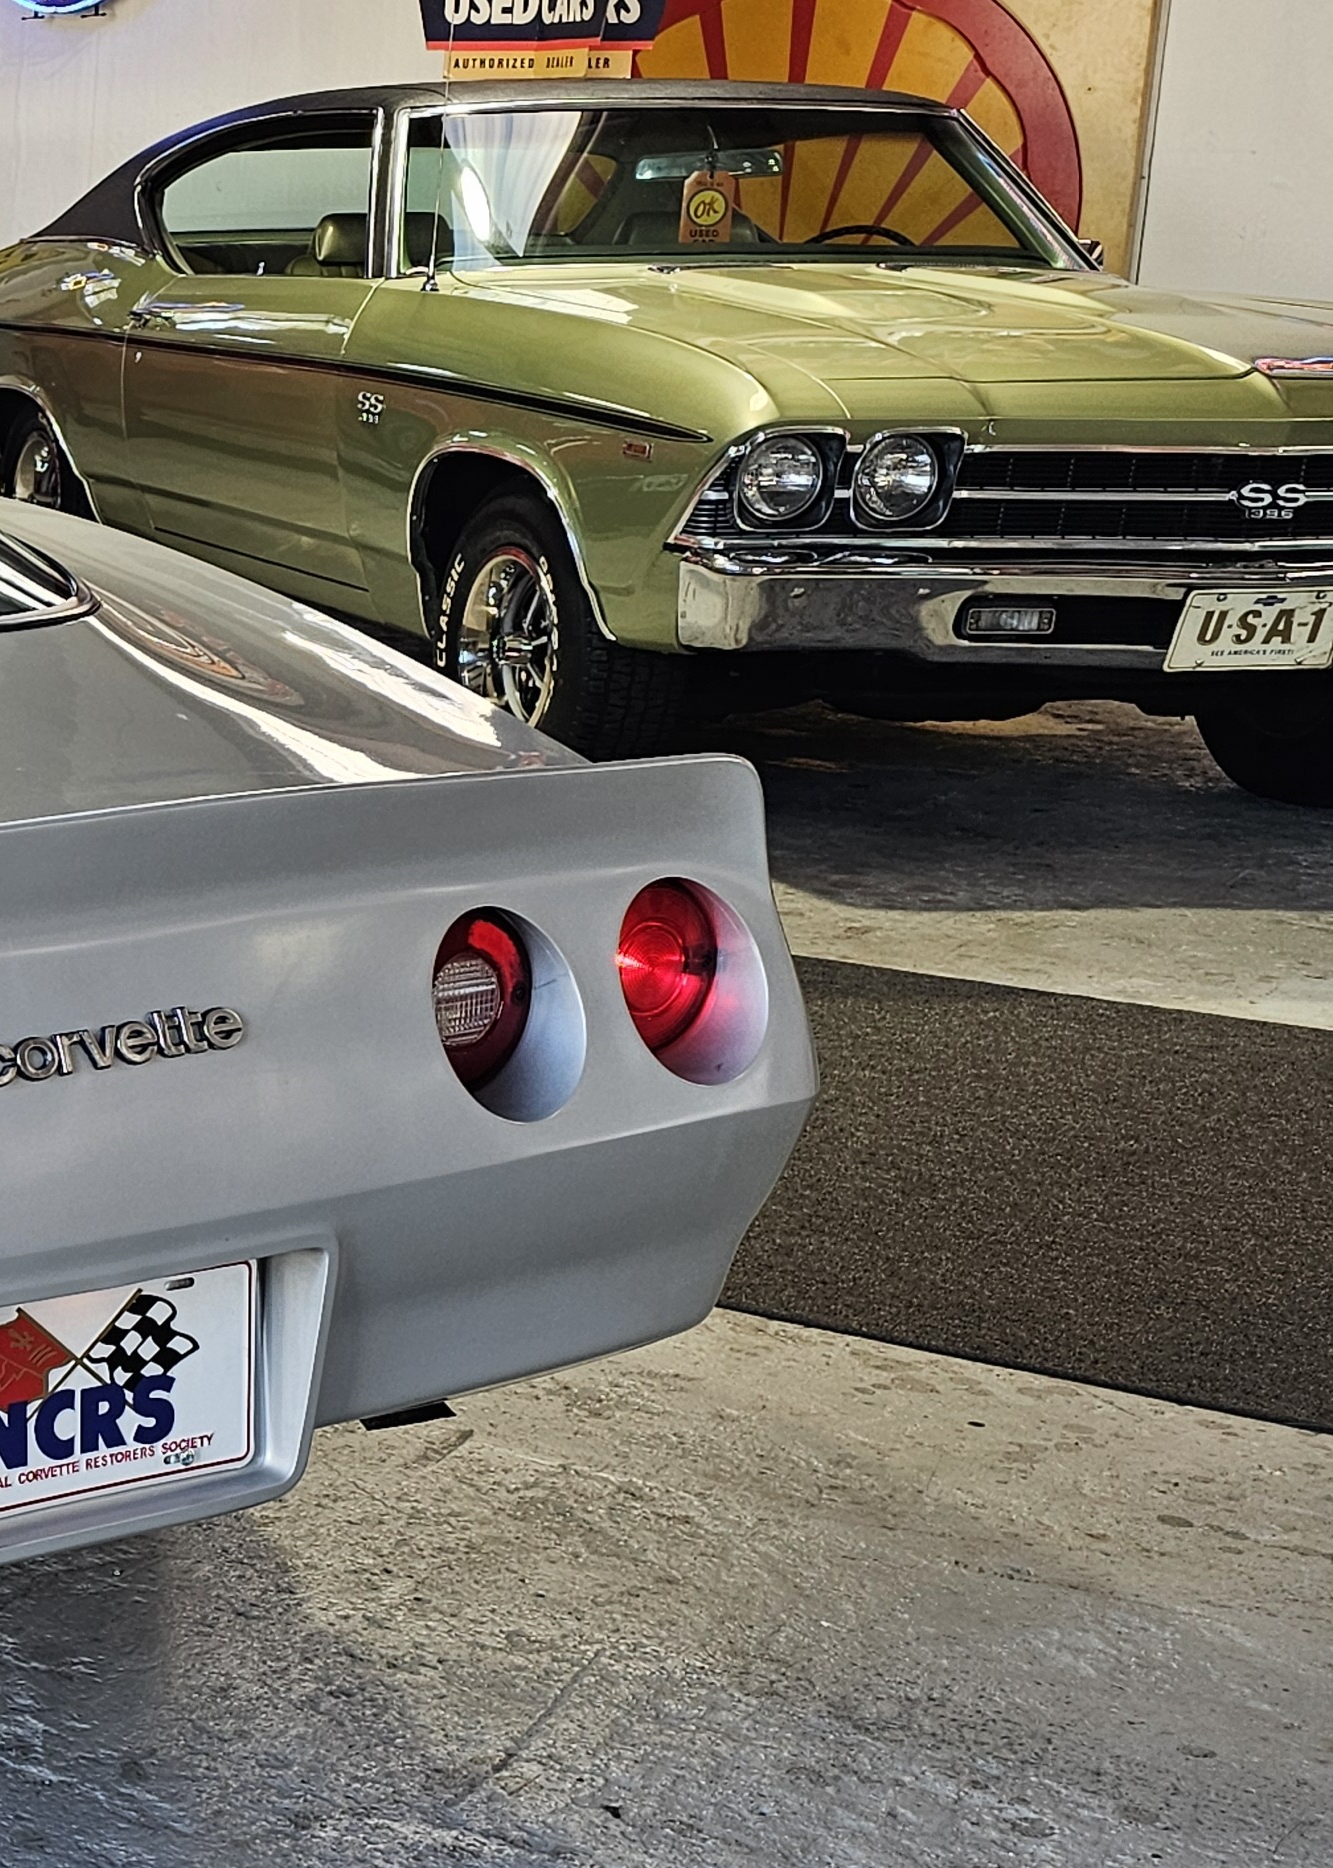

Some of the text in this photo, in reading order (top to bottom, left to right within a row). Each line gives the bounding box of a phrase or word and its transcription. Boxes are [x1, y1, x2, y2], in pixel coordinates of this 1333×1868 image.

[444, 0, 595, 24] USED CARS
[453, 55, 575, 69] AUTHORIZED DEALER
[693, 196, 720, 219] OK
[689, 229, 720, 238] USED
[357, 391, 384, 413] SS
[1238, 483, 1307, 507] SS
[436, 553, 465, 667] CLASSIC
[18, 1460, 80, 1485] CORVETTE
[85, 1445, 156, 1471] RESTORERS
[161, 1432, 215, 1455] SOCIETY
